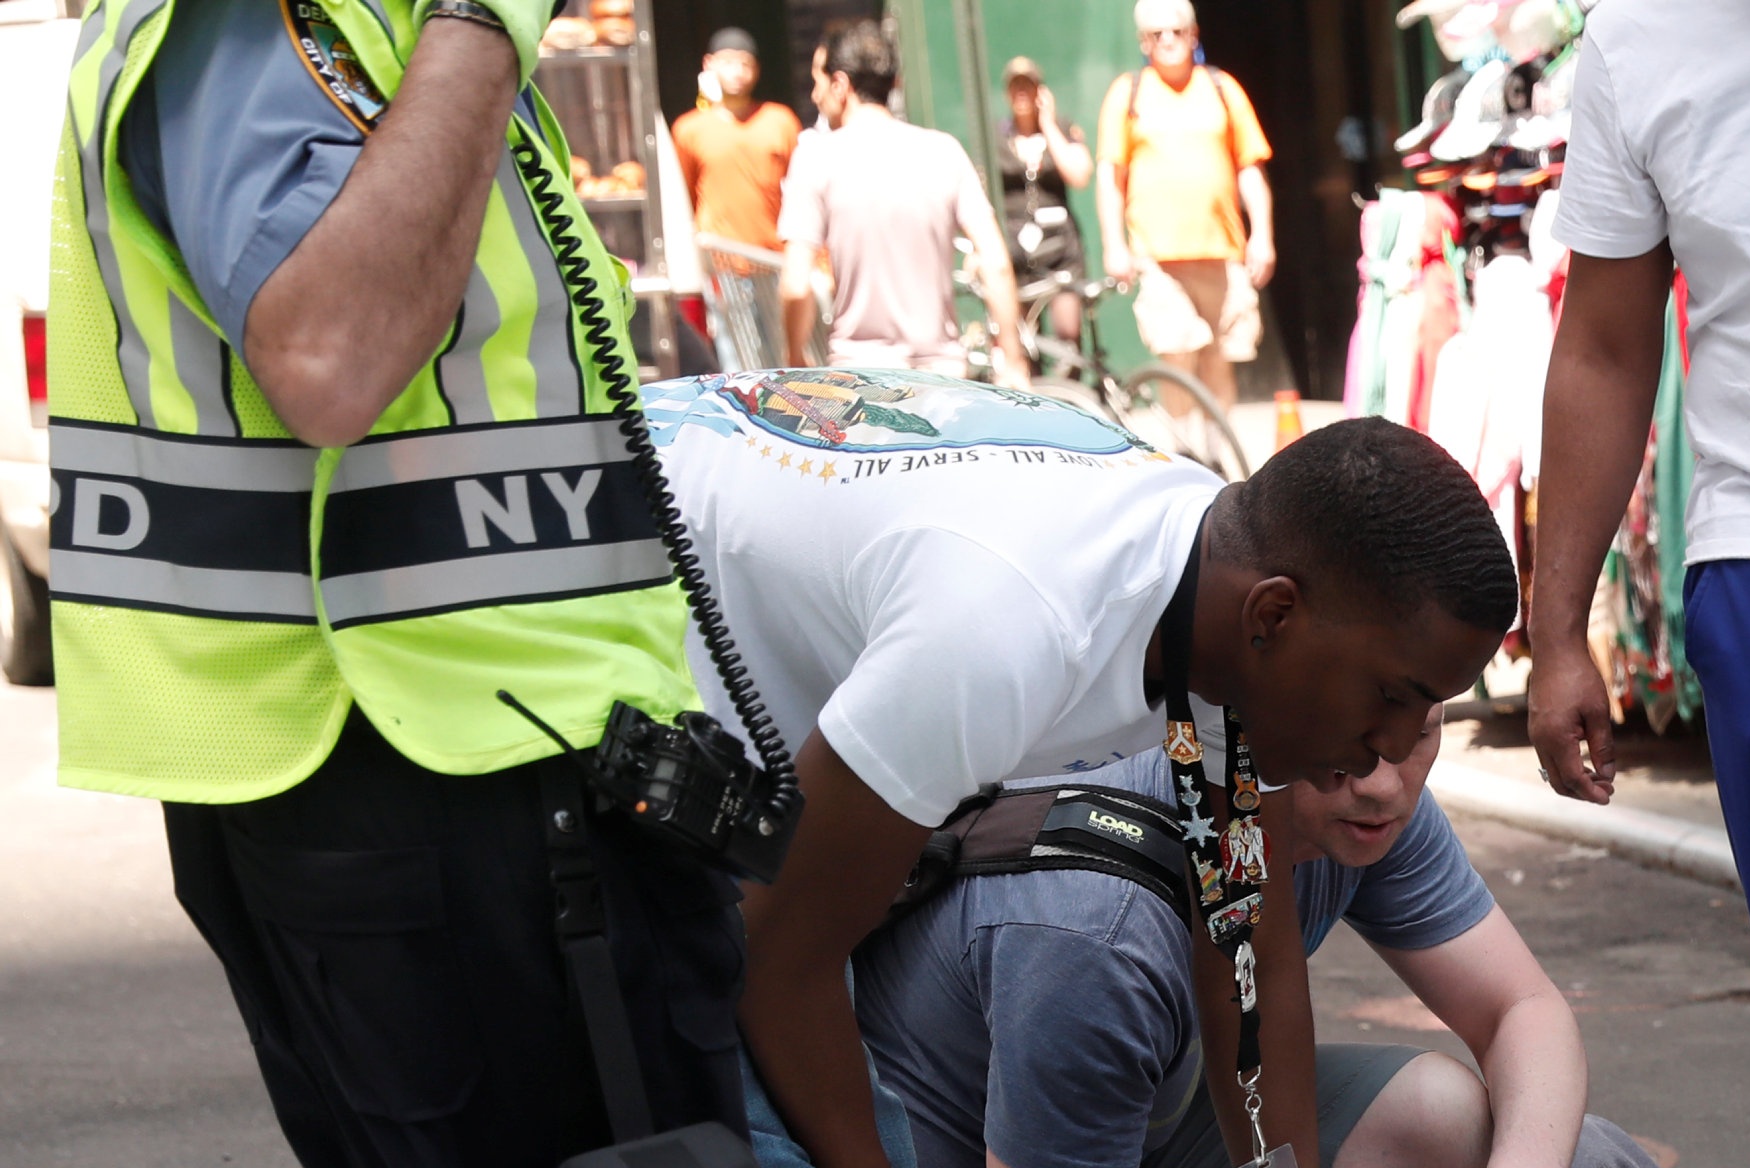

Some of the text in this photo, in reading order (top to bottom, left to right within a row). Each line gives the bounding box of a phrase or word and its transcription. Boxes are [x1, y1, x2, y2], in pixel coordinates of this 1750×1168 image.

[301, 38, 333, 76] CITY
[853, 458, 891, 479] ALL
[899, 449, 980, 473] SERVE
[1004, 449, 1046, 464] ALL
[51, 478, 150, 551] D
[455, 468, 604, 548] NY
[1089, 810, 1144, 837] LOAD
